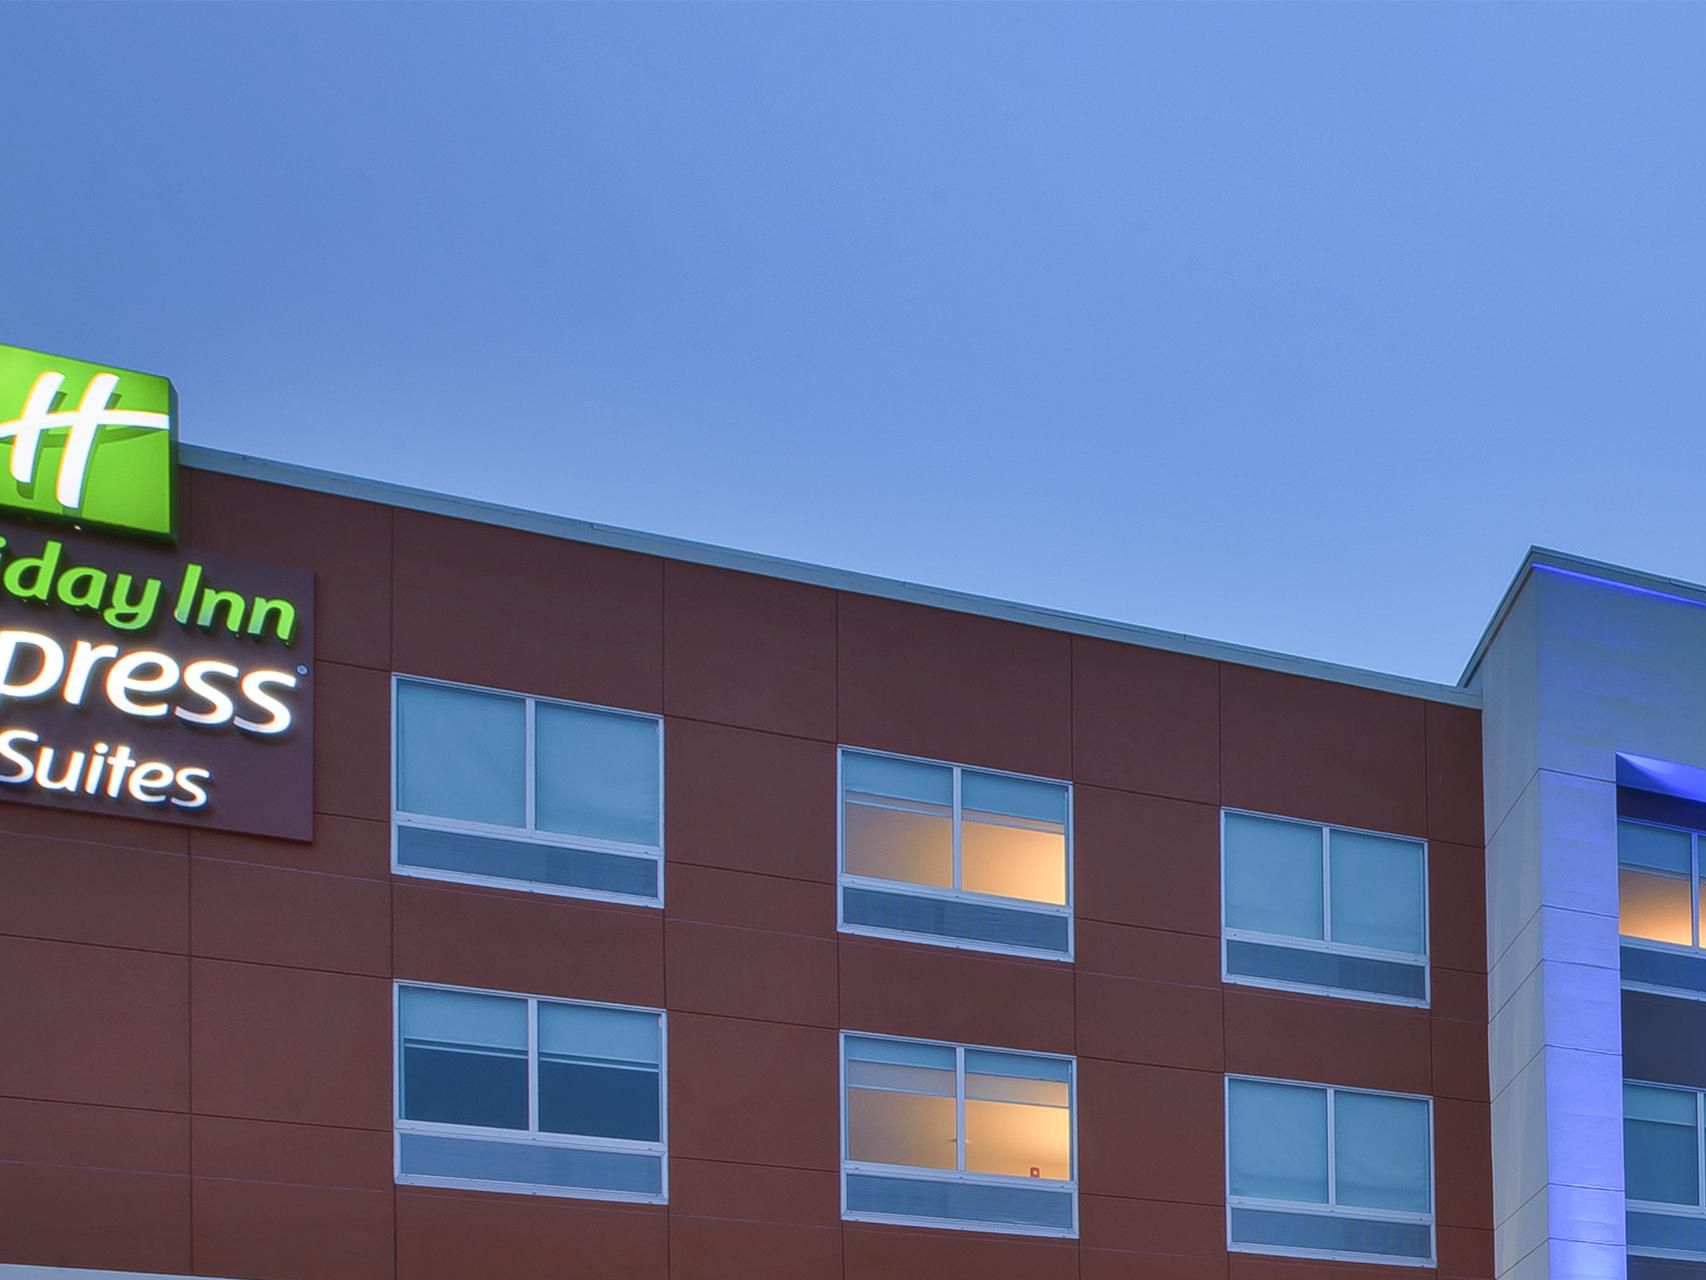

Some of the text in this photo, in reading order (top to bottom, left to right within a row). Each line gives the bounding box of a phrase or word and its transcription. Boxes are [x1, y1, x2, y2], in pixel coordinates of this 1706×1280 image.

[0, 536, 296, 642] day Inn
[0, 728, 211, 808] Suites
